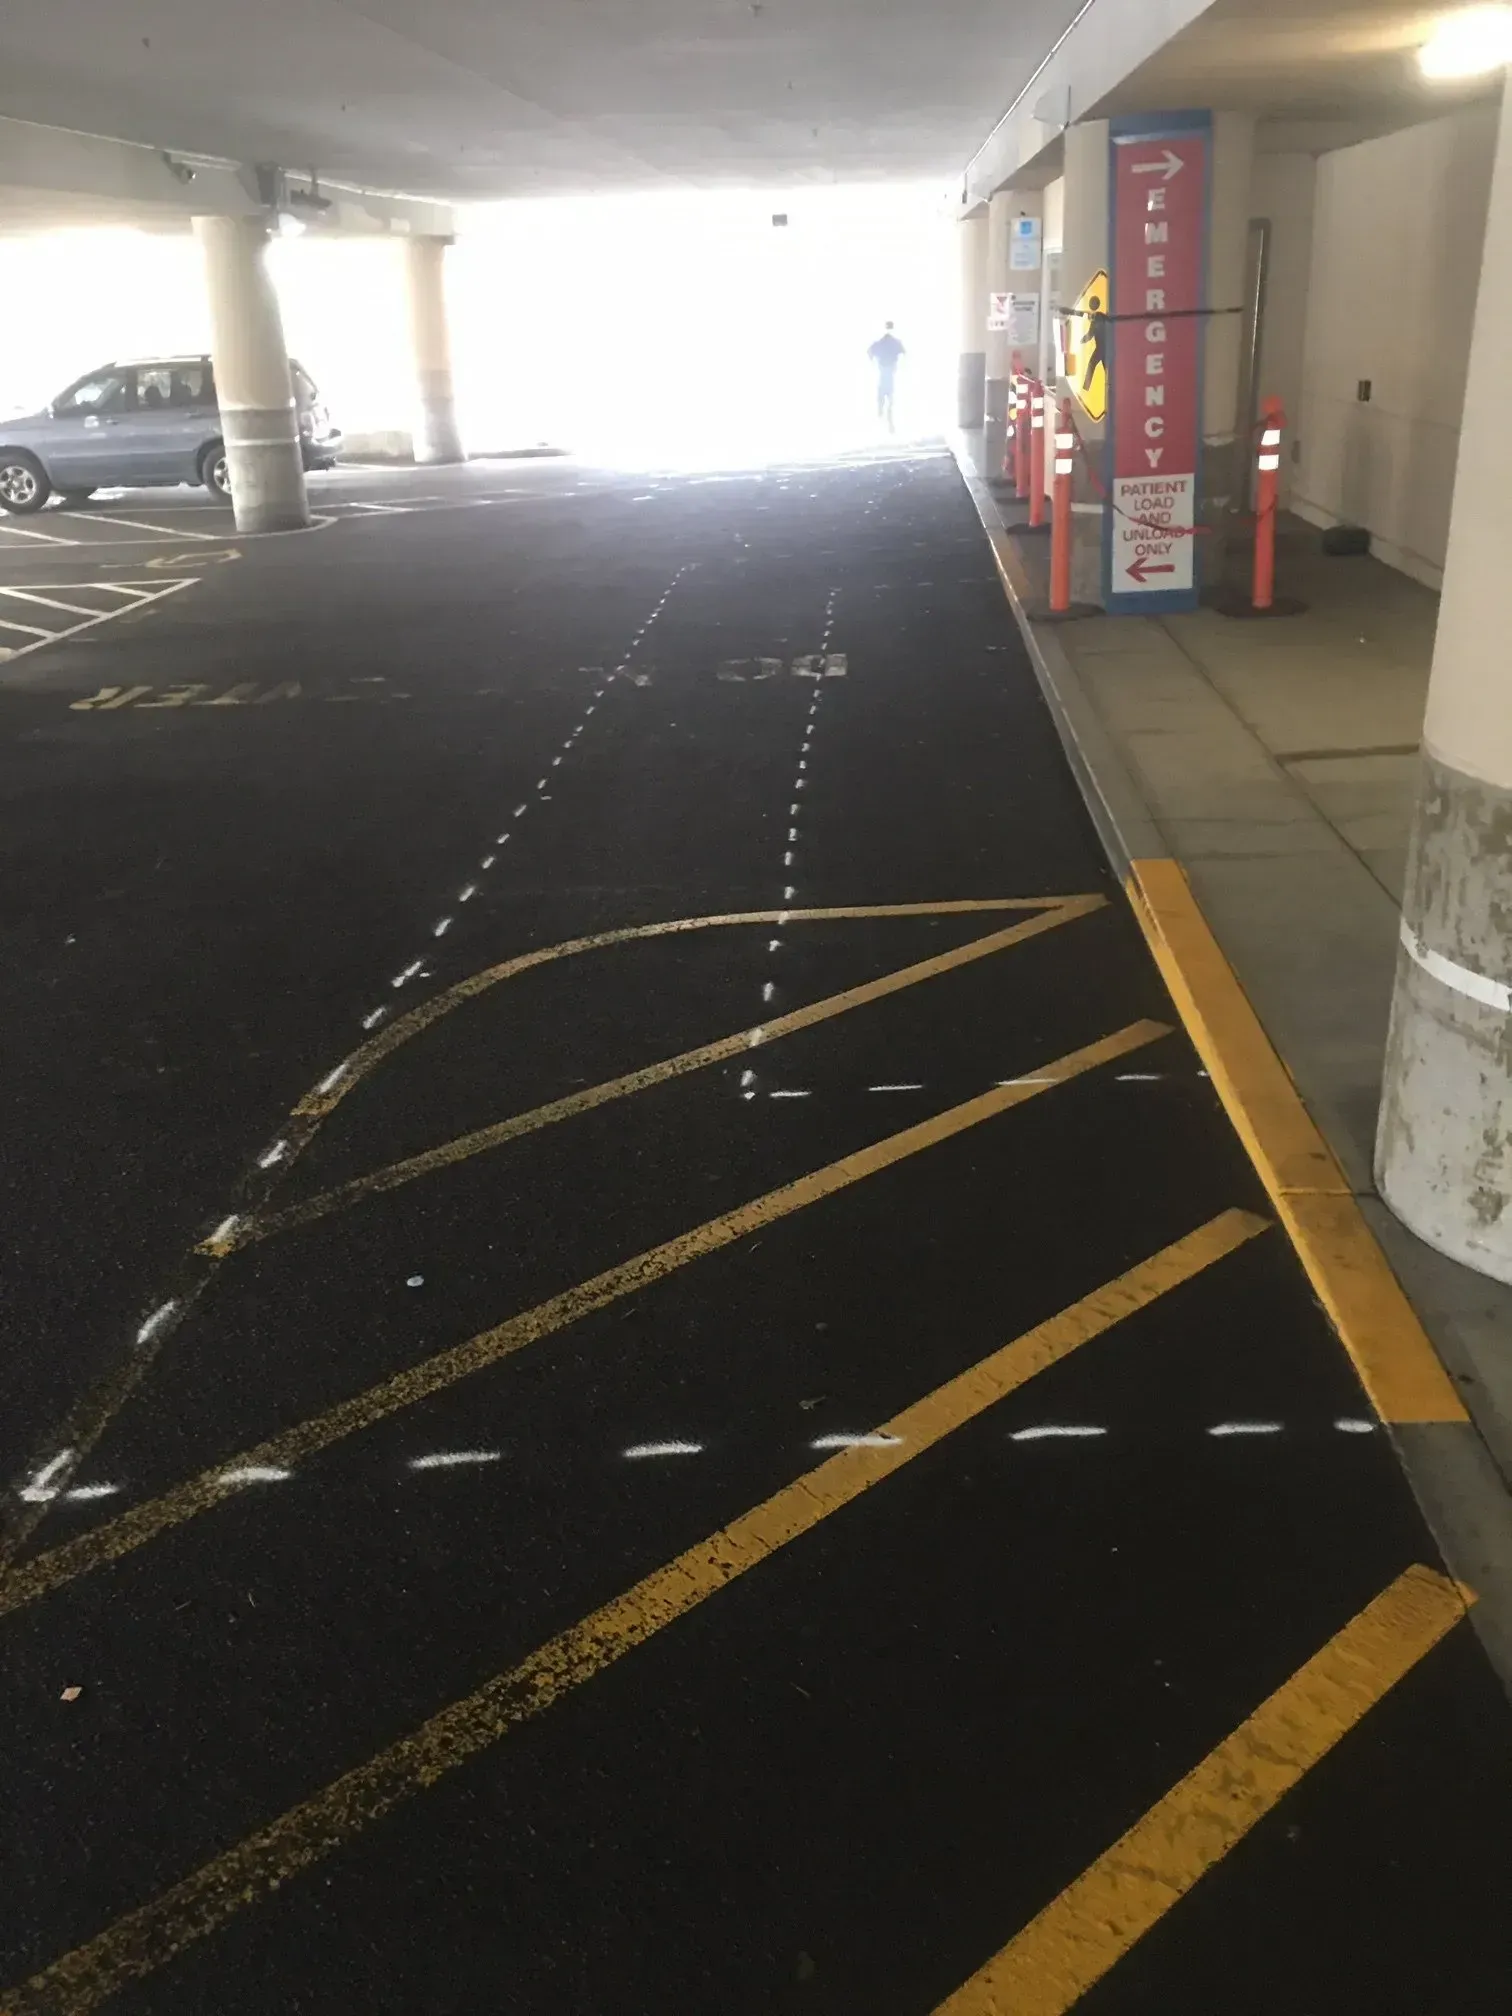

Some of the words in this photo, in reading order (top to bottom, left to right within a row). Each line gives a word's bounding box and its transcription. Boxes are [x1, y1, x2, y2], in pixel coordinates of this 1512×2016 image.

[1144, 187, 1168, 469] EMERGENCY
[1121, 480, 1187, 497] PATIENT
[1134, 497, 1174, 511] LOAD
[1138, 511, 1171, 525] AND
[1123, 526, 1185, 542] UNLOAD
[1135, 542, 1173, 556] ONLY
